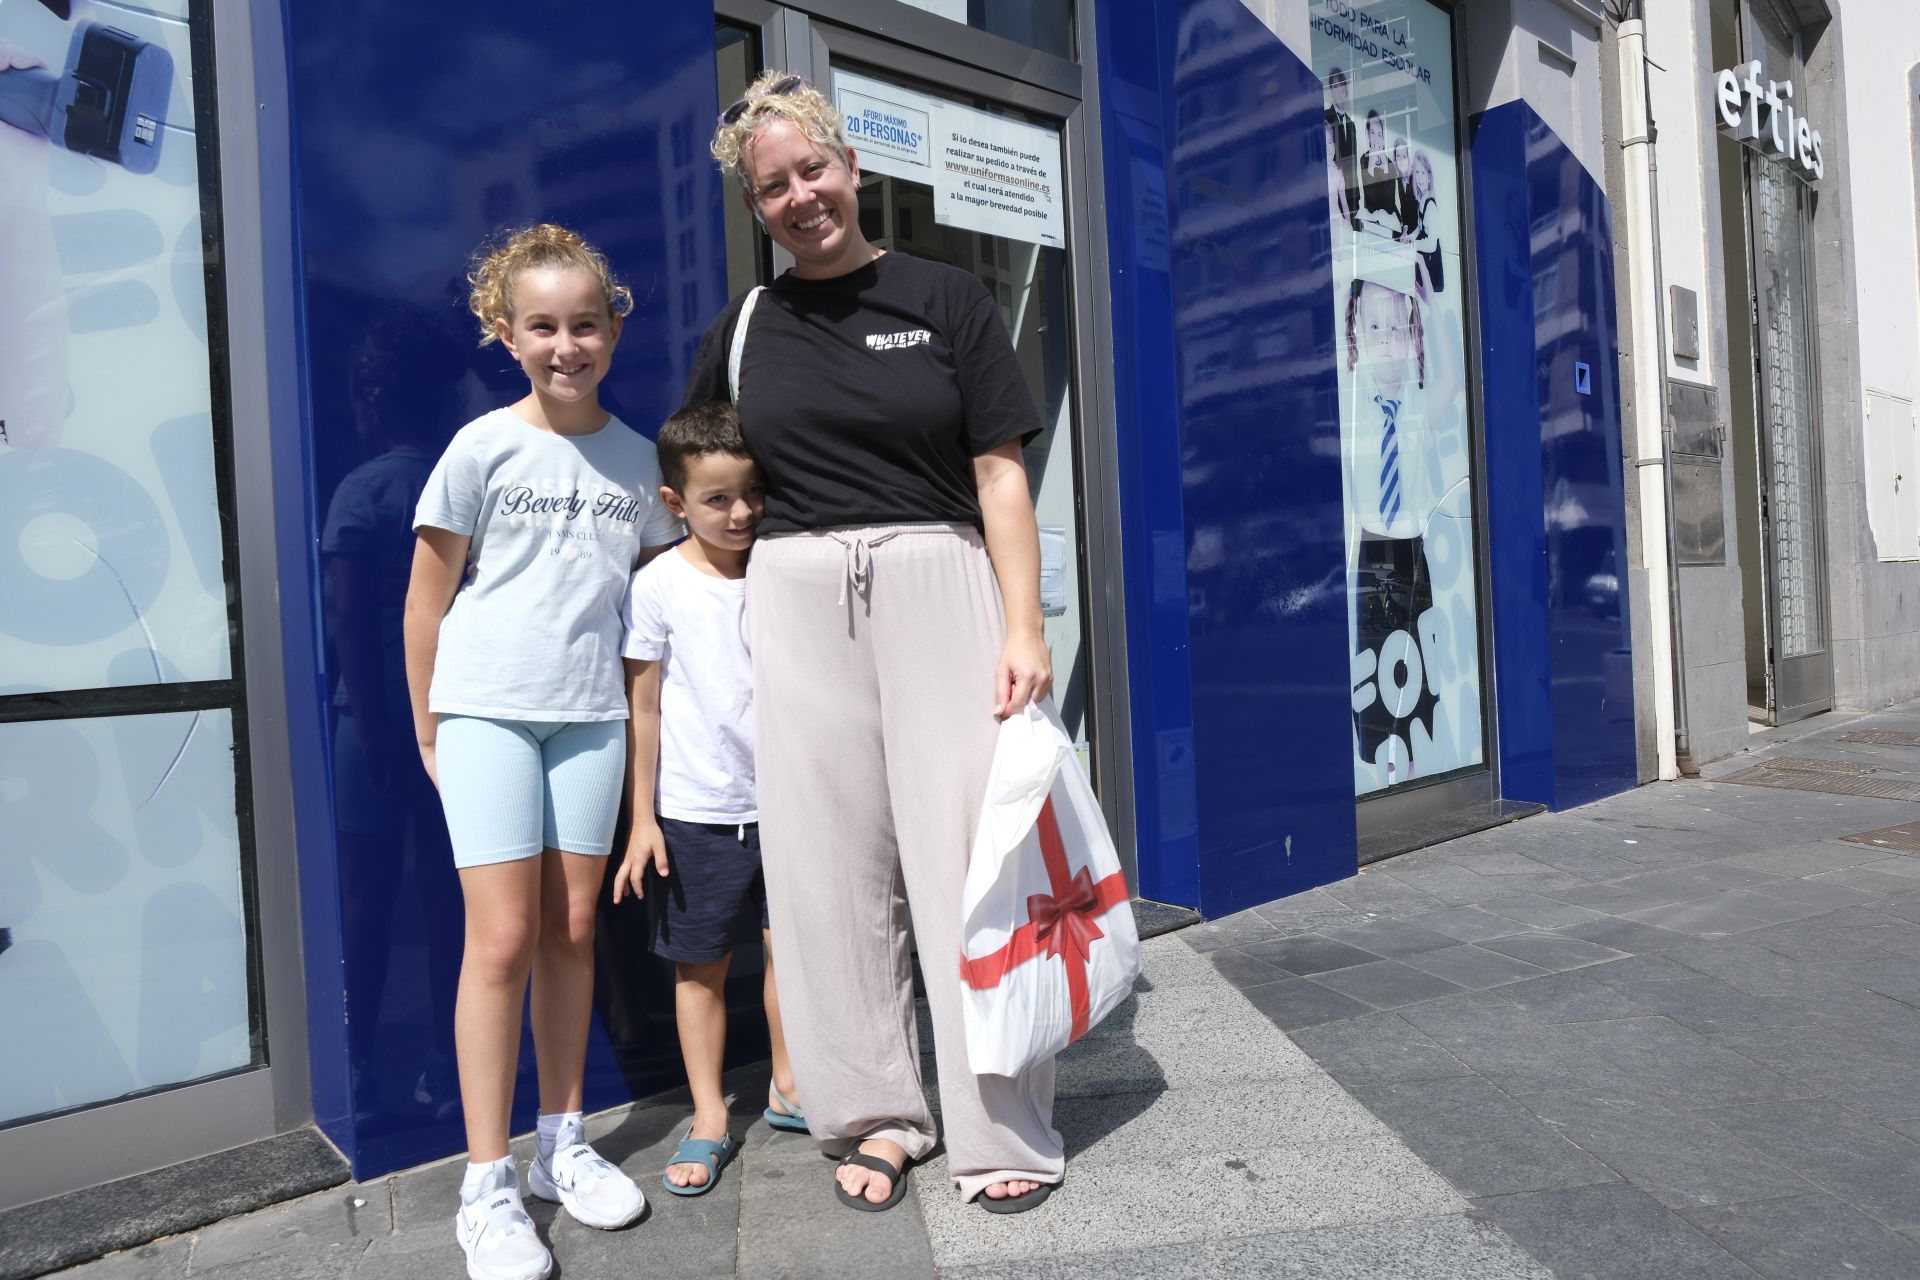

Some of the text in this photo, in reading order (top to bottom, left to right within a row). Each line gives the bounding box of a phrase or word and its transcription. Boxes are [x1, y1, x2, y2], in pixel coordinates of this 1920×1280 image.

[1325, 0, 1407, 48] TODO PARA LA
[1381, 48, 1431, 84] ESCOLAR
[847, 115, 860, 133] 20
[863, 108, 907, 129] AFORO MÁXIMO
[946, 147, 1047, 178] realizar su pedido a través de
[951, 132, 1040, 163] Si lo desea también puede
[944, 160, 1050, 193] www.uniformasonline.es
[963, 180, 1035, 203] el cual será atendido
[950, 191, 1048, 220] a la mayor brevedad posible
[865, 329, 931, 347] WHATEVER
[501, 486, 587, 520] Beverly
[592, 492, 640, 524] Hills
